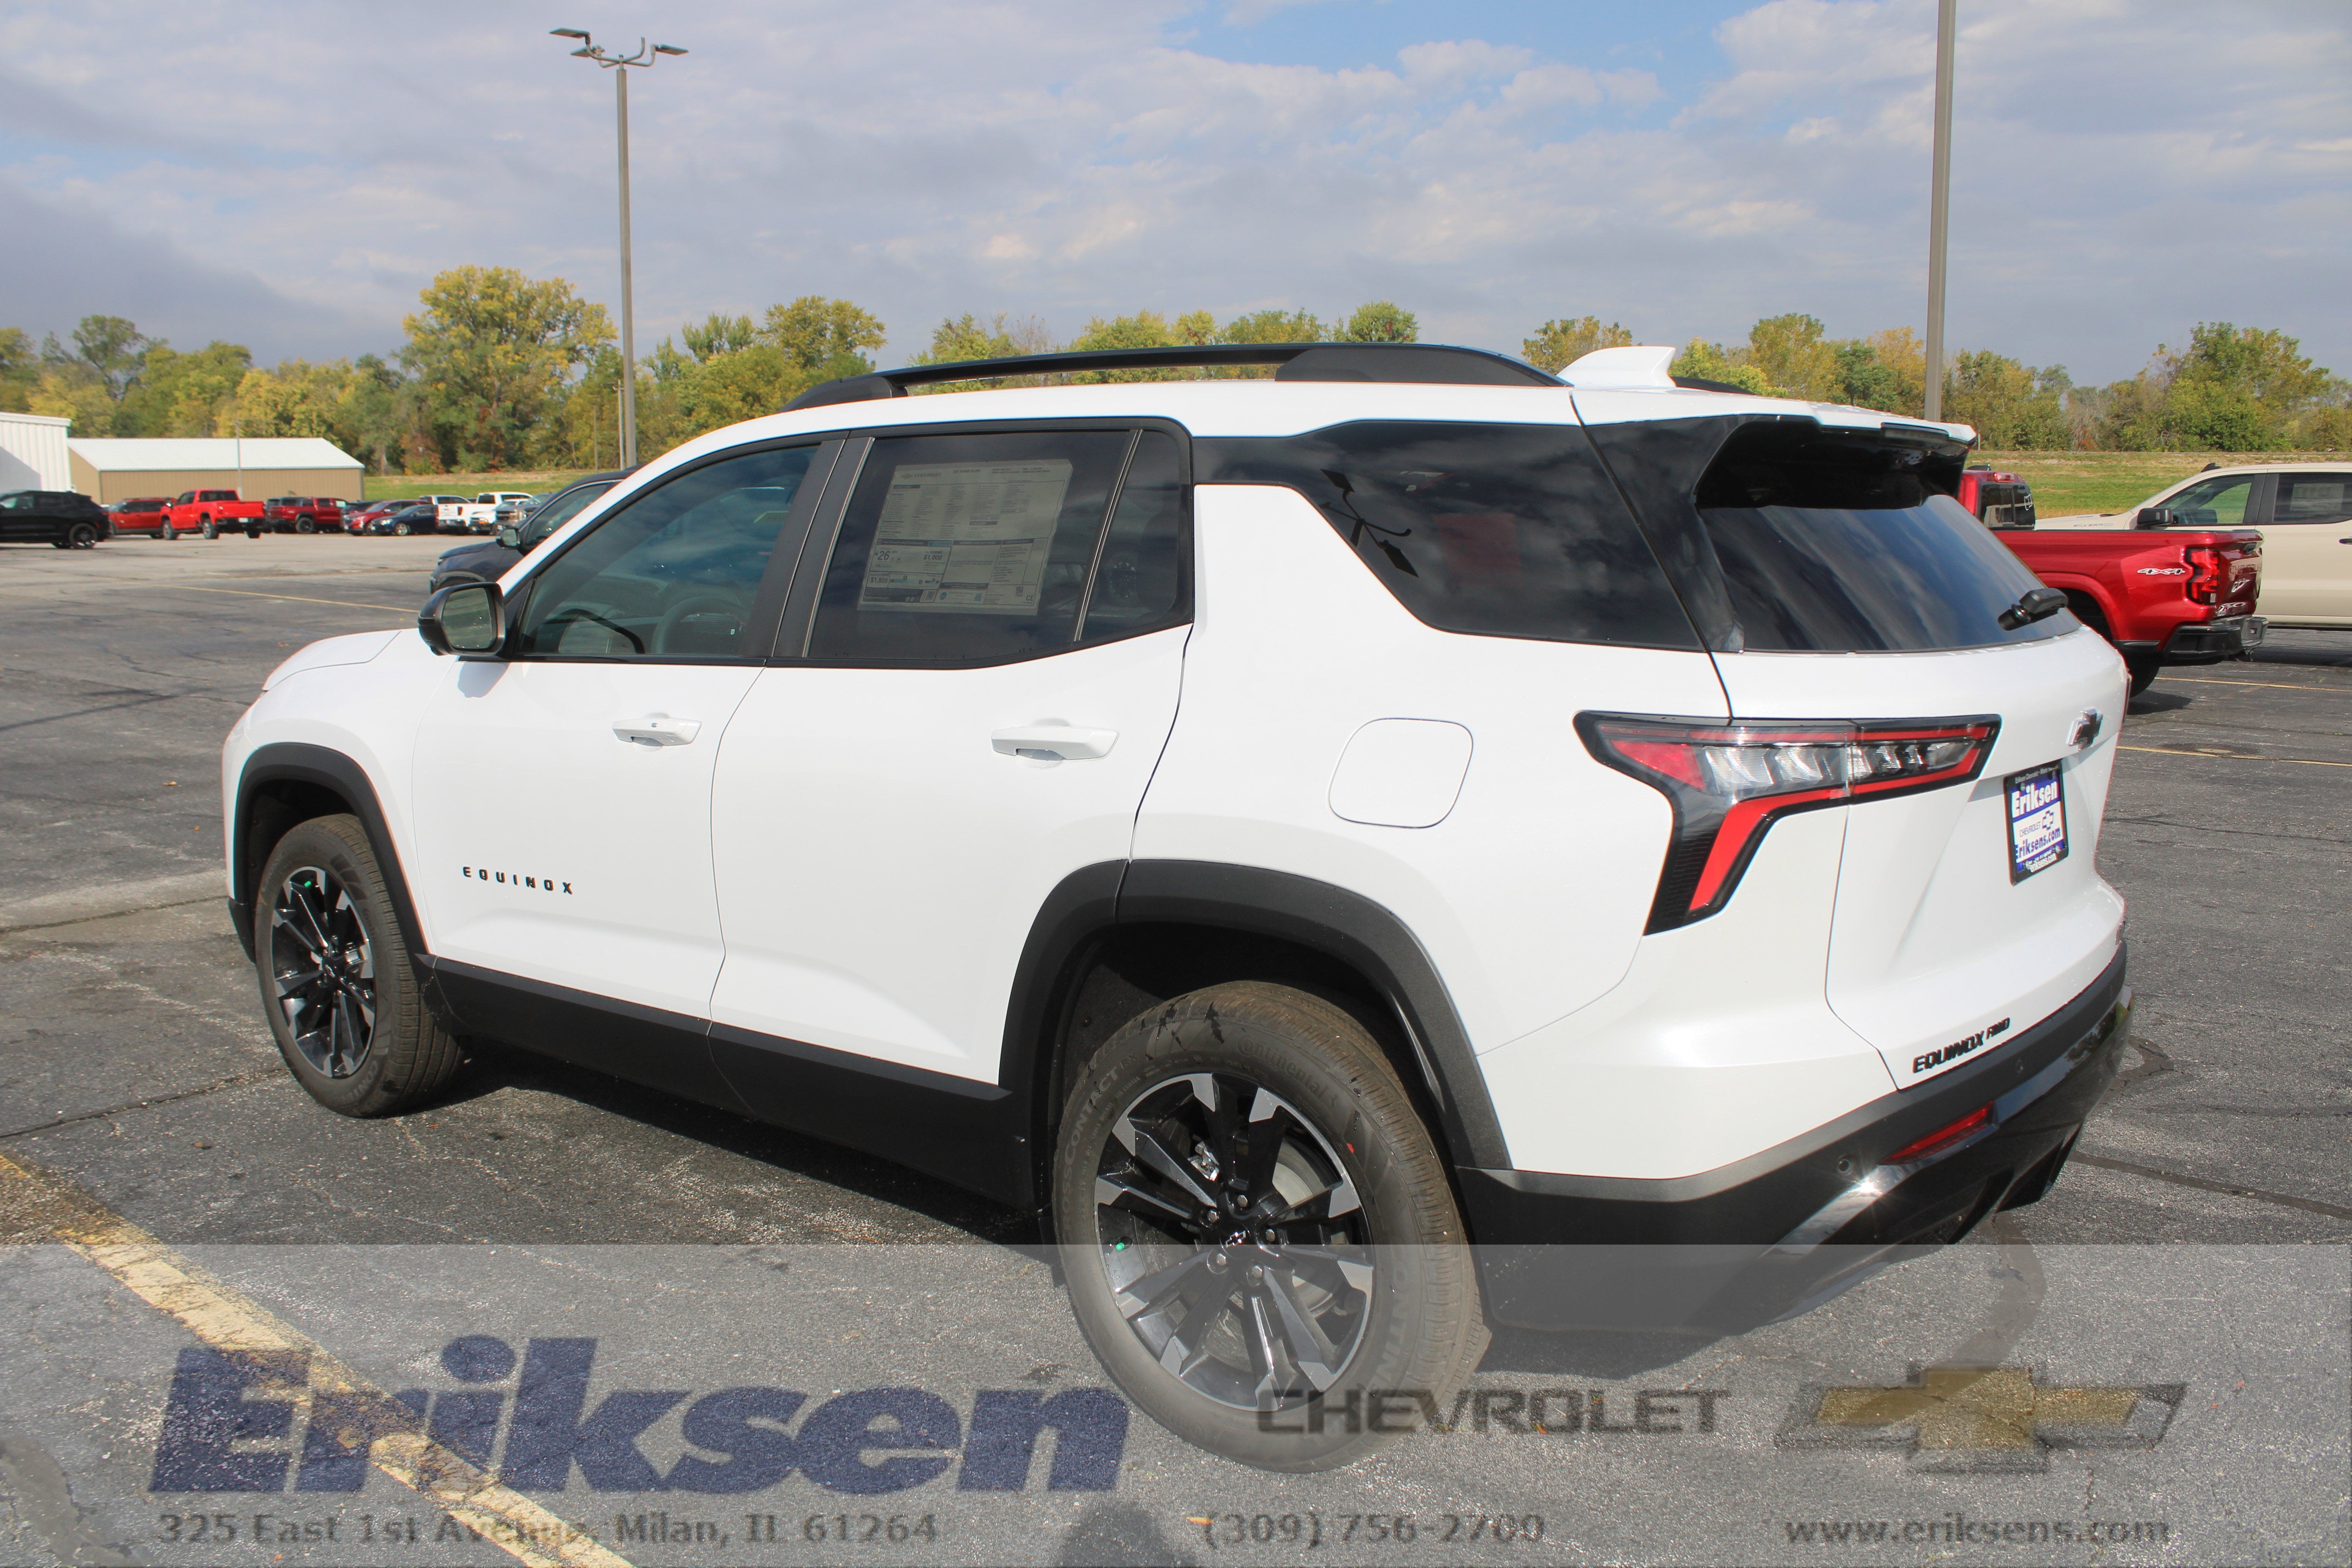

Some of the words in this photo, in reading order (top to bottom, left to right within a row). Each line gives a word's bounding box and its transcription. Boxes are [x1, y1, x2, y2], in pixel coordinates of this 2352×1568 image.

[878, 550, 891, 561] 26
[2011, 781, 2058, 818] Eriksen
[2019, 821, 2041, 837] CHEVROLET
[463, 866, 573, 895] EQUINOX
[1913, 1031, 1984, 1073] EQUINOX
